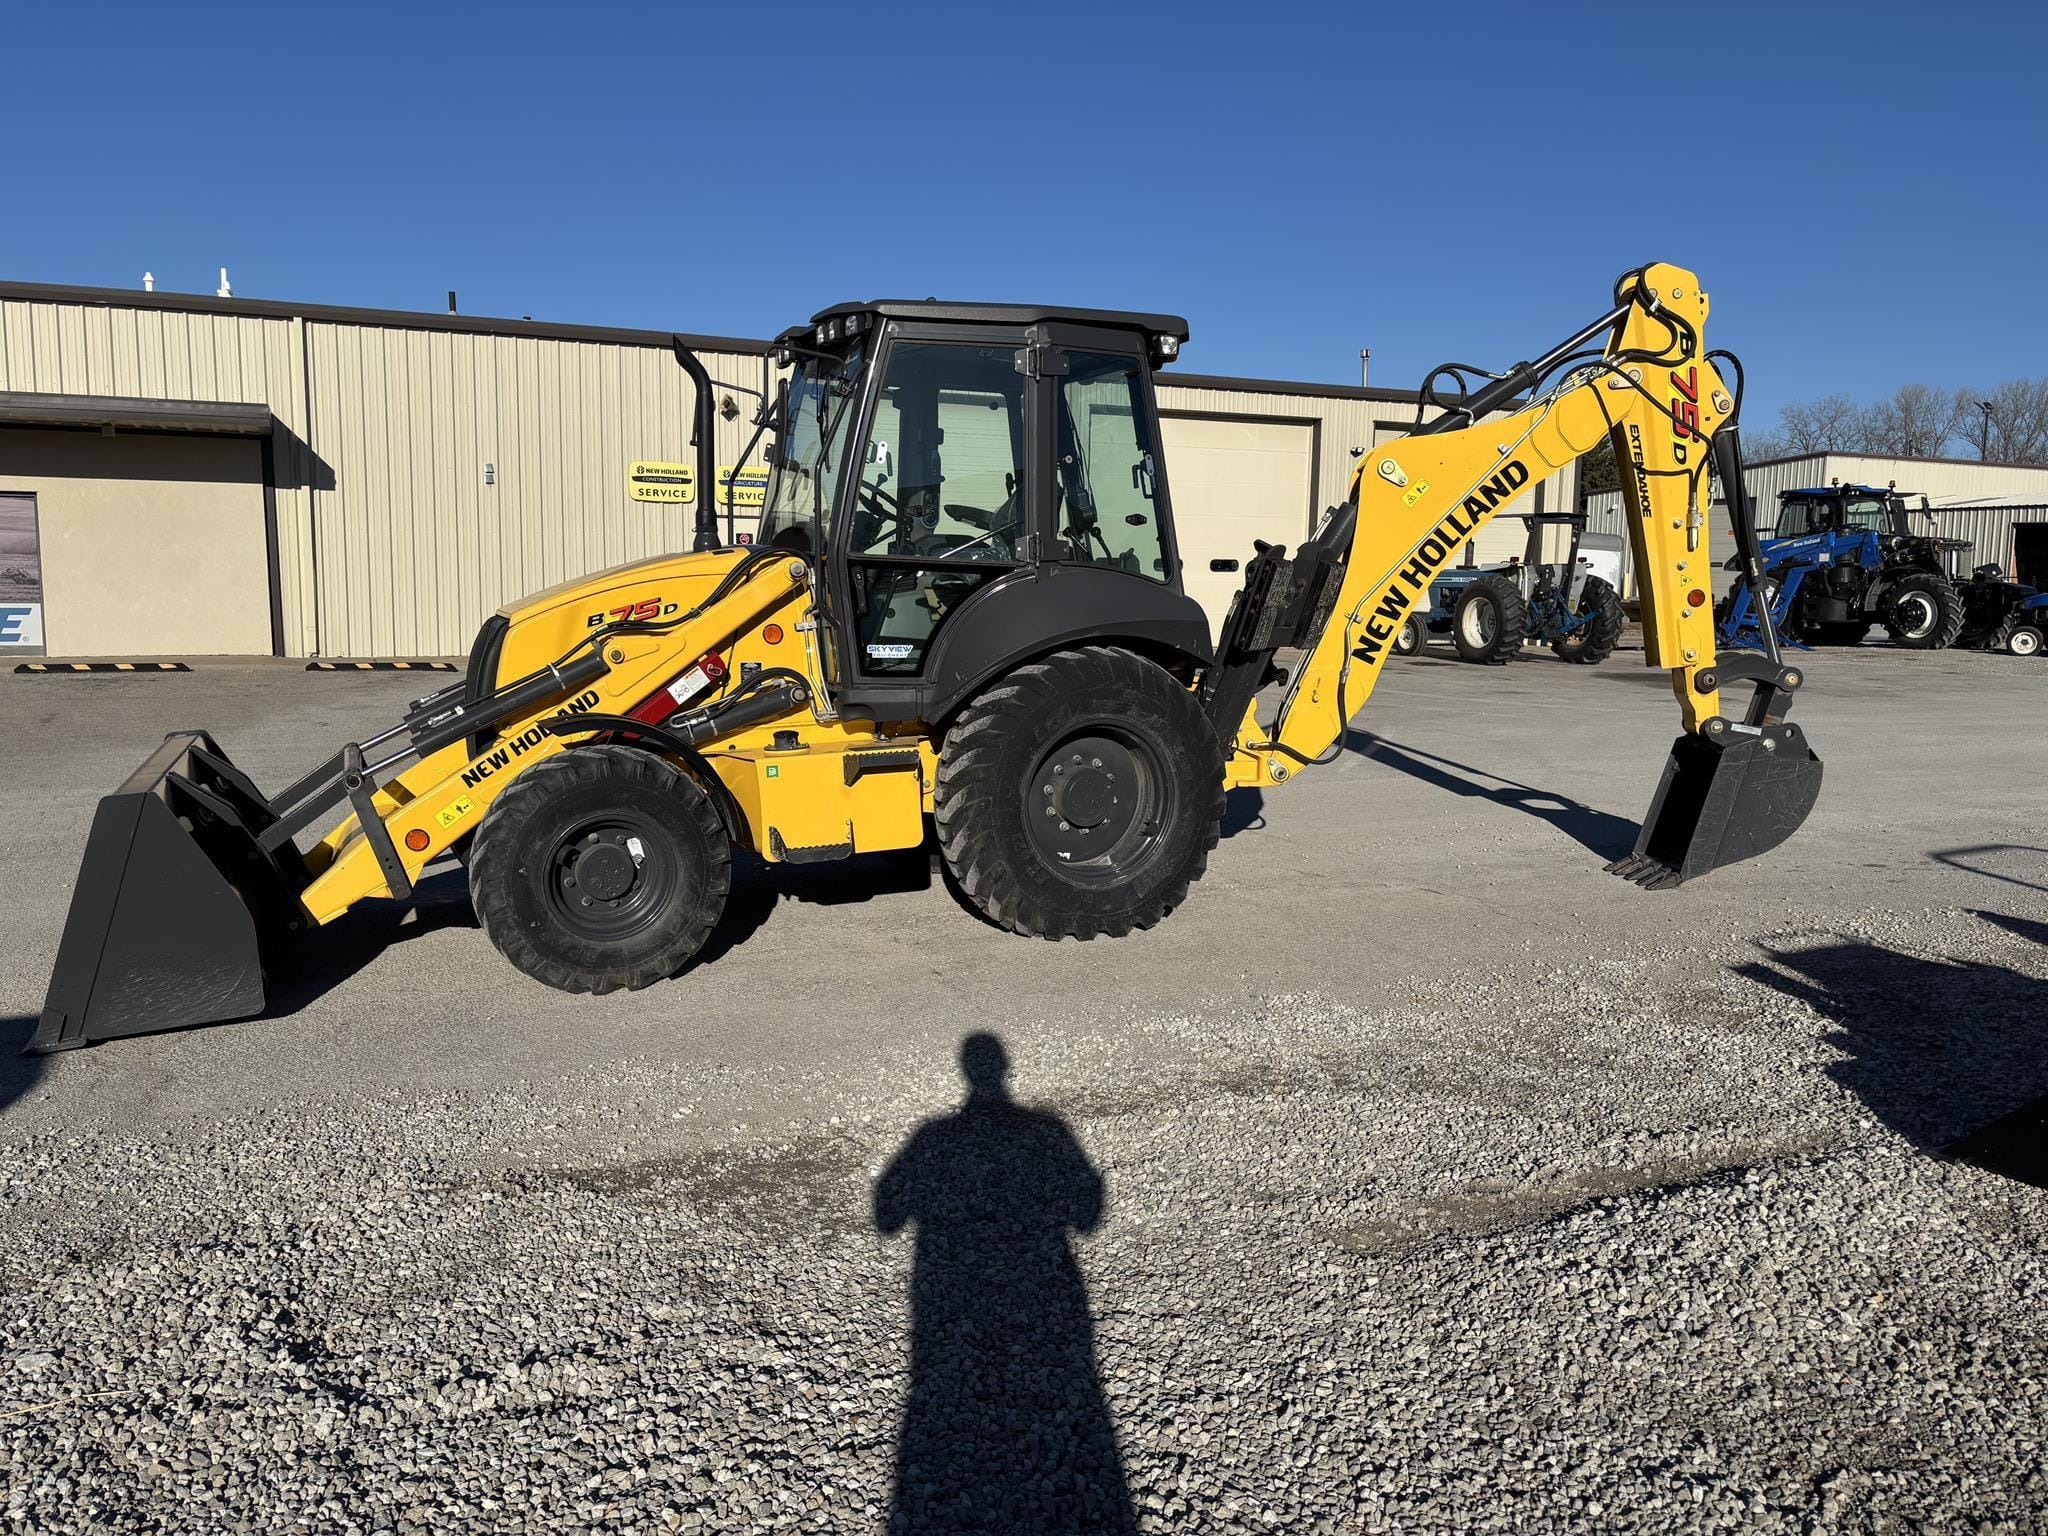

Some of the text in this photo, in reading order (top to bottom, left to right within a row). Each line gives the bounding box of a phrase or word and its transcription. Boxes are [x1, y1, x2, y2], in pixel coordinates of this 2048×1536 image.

[638, 488, 687, 498] SERVICE
[724, 492, 764, 500] SERVIC
[1352, 460, 1529, 666] NEW HOLLAND
[460, 689, 600, 789] NEW HOLAND
